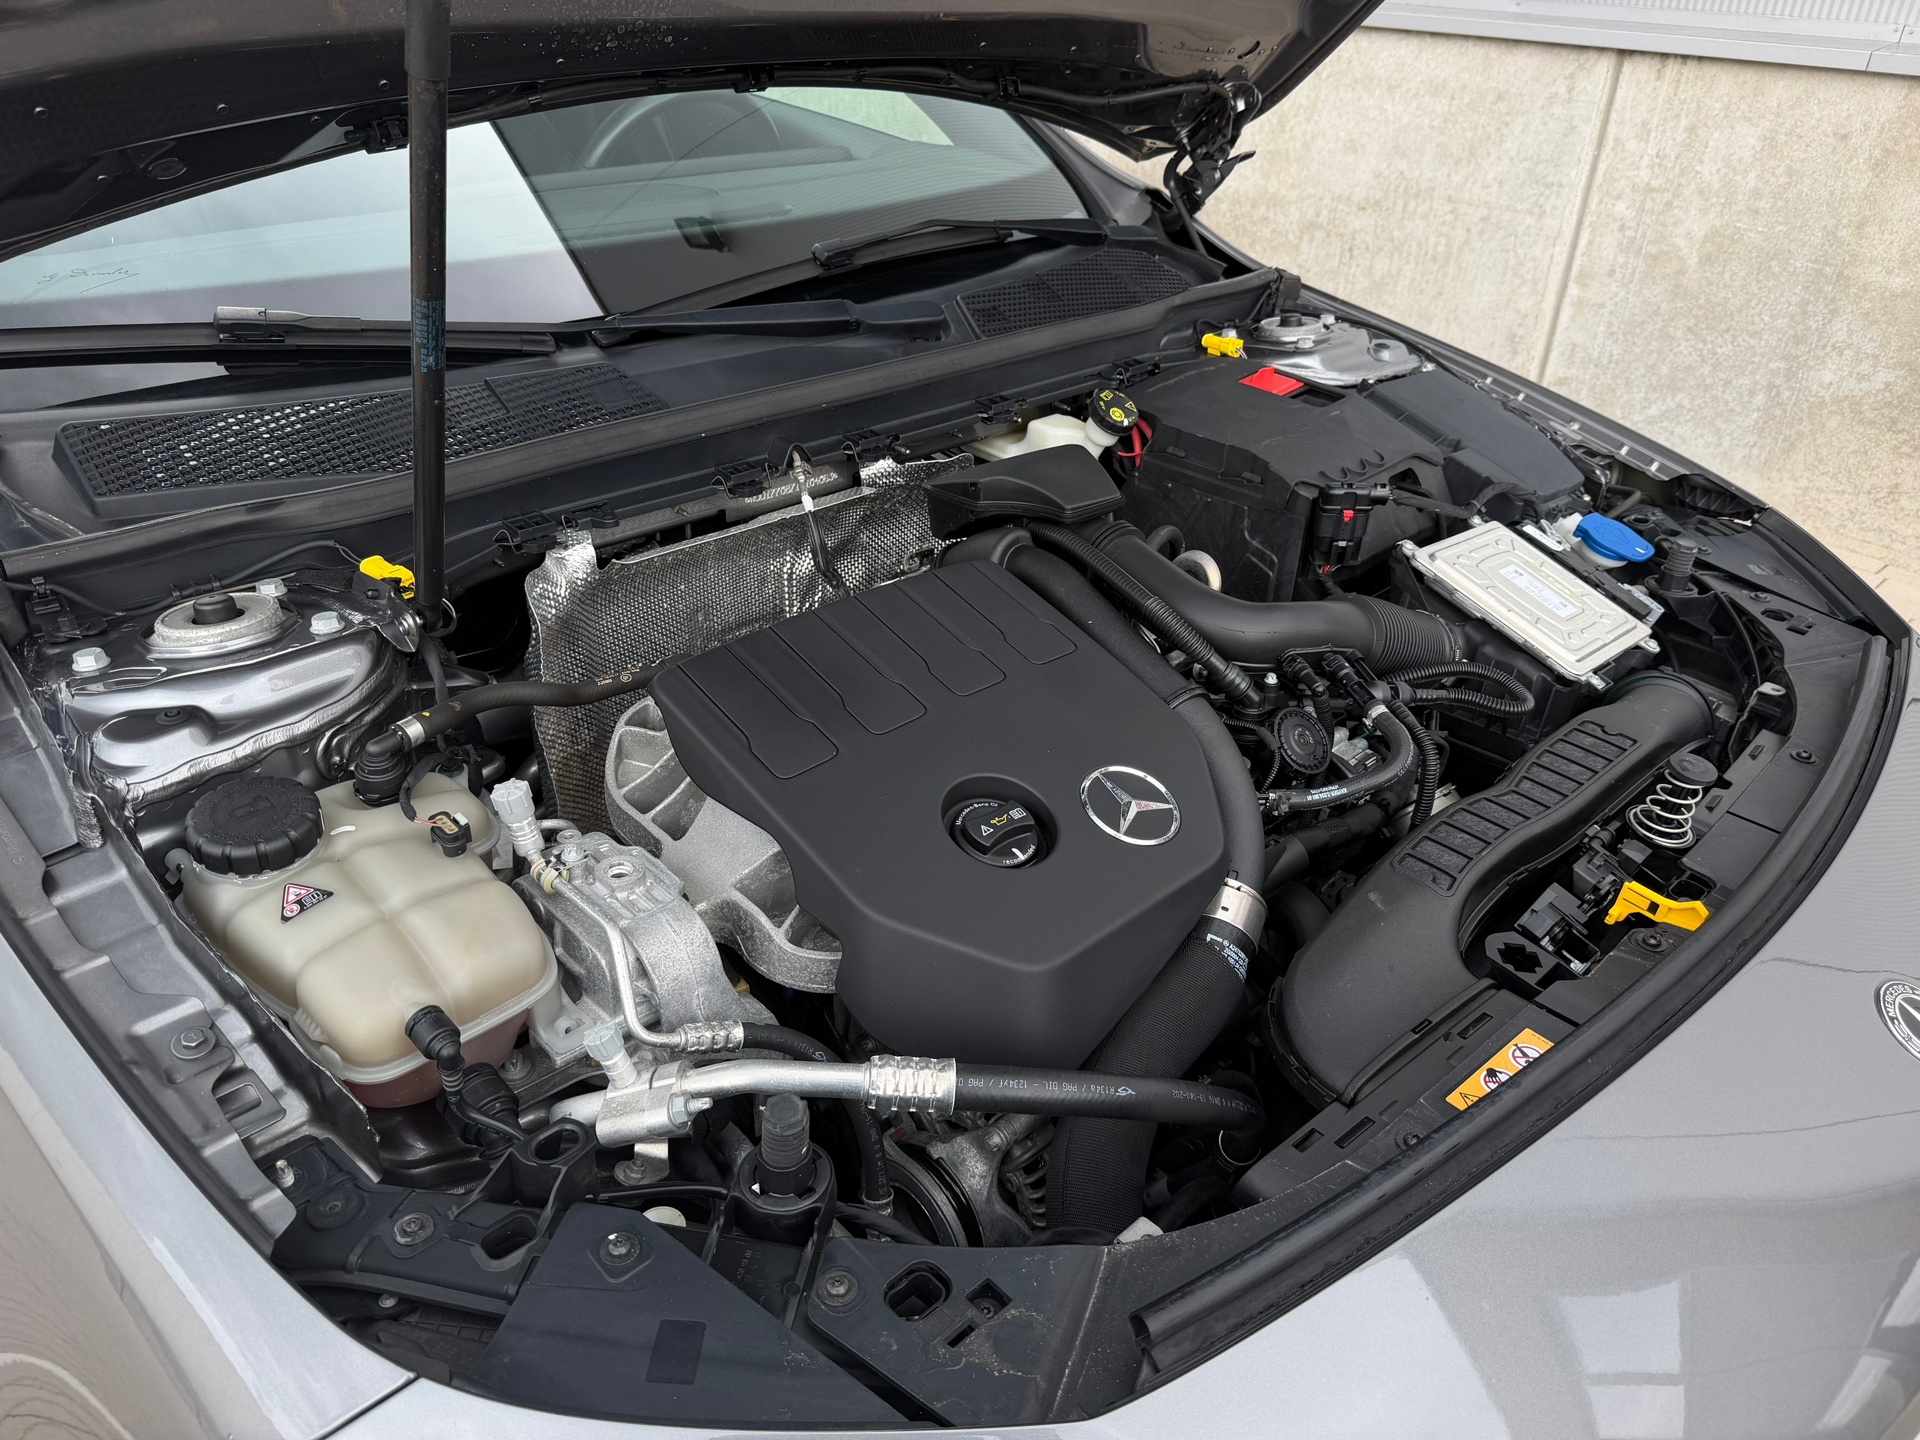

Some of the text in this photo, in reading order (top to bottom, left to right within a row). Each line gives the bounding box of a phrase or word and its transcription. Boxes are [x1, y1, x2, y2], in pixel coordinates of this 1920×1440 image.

[955, 802, 989, 826] Mercedes-Benz
[968, 1077, 984, 1087] PAG
[998, 1078, 1028, 1089] 1234yf
[1043, 1080, 1058, 1091] OIL
[1062, 1082, 1078, 1092] PAG
[1090, 1084, 1115, 1095] R134a
